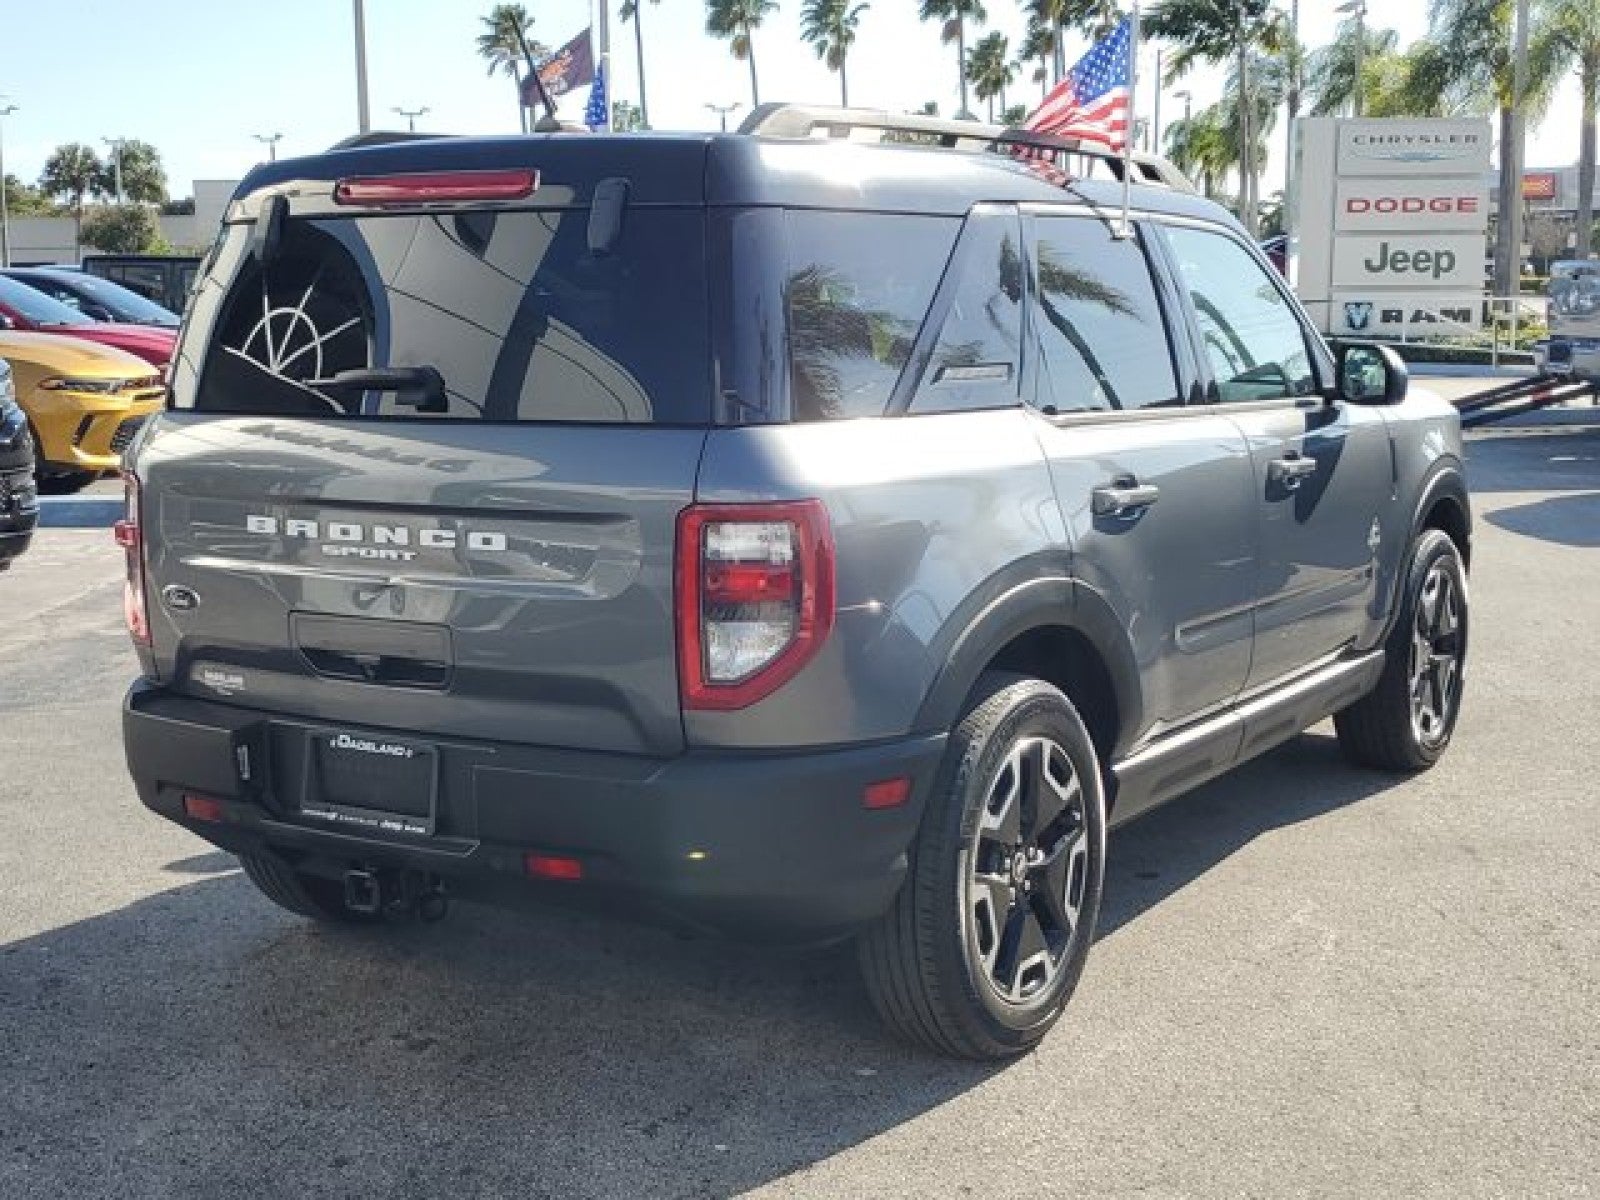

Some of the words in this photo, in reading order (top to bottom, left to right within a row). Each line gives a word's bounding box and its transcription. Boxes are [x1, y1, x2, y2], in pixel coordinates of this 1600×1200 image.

[1353, 134, 1478, 144] CHRYSLER
[1347, 197, 1478, 213] DODGE
[1364, 242, 1456, 279] Jeep
[1380, 308, 1472, 323] RAM
[246, 515, 507, 551] BRONCO
[321, 544, 418, 561] SPORT
